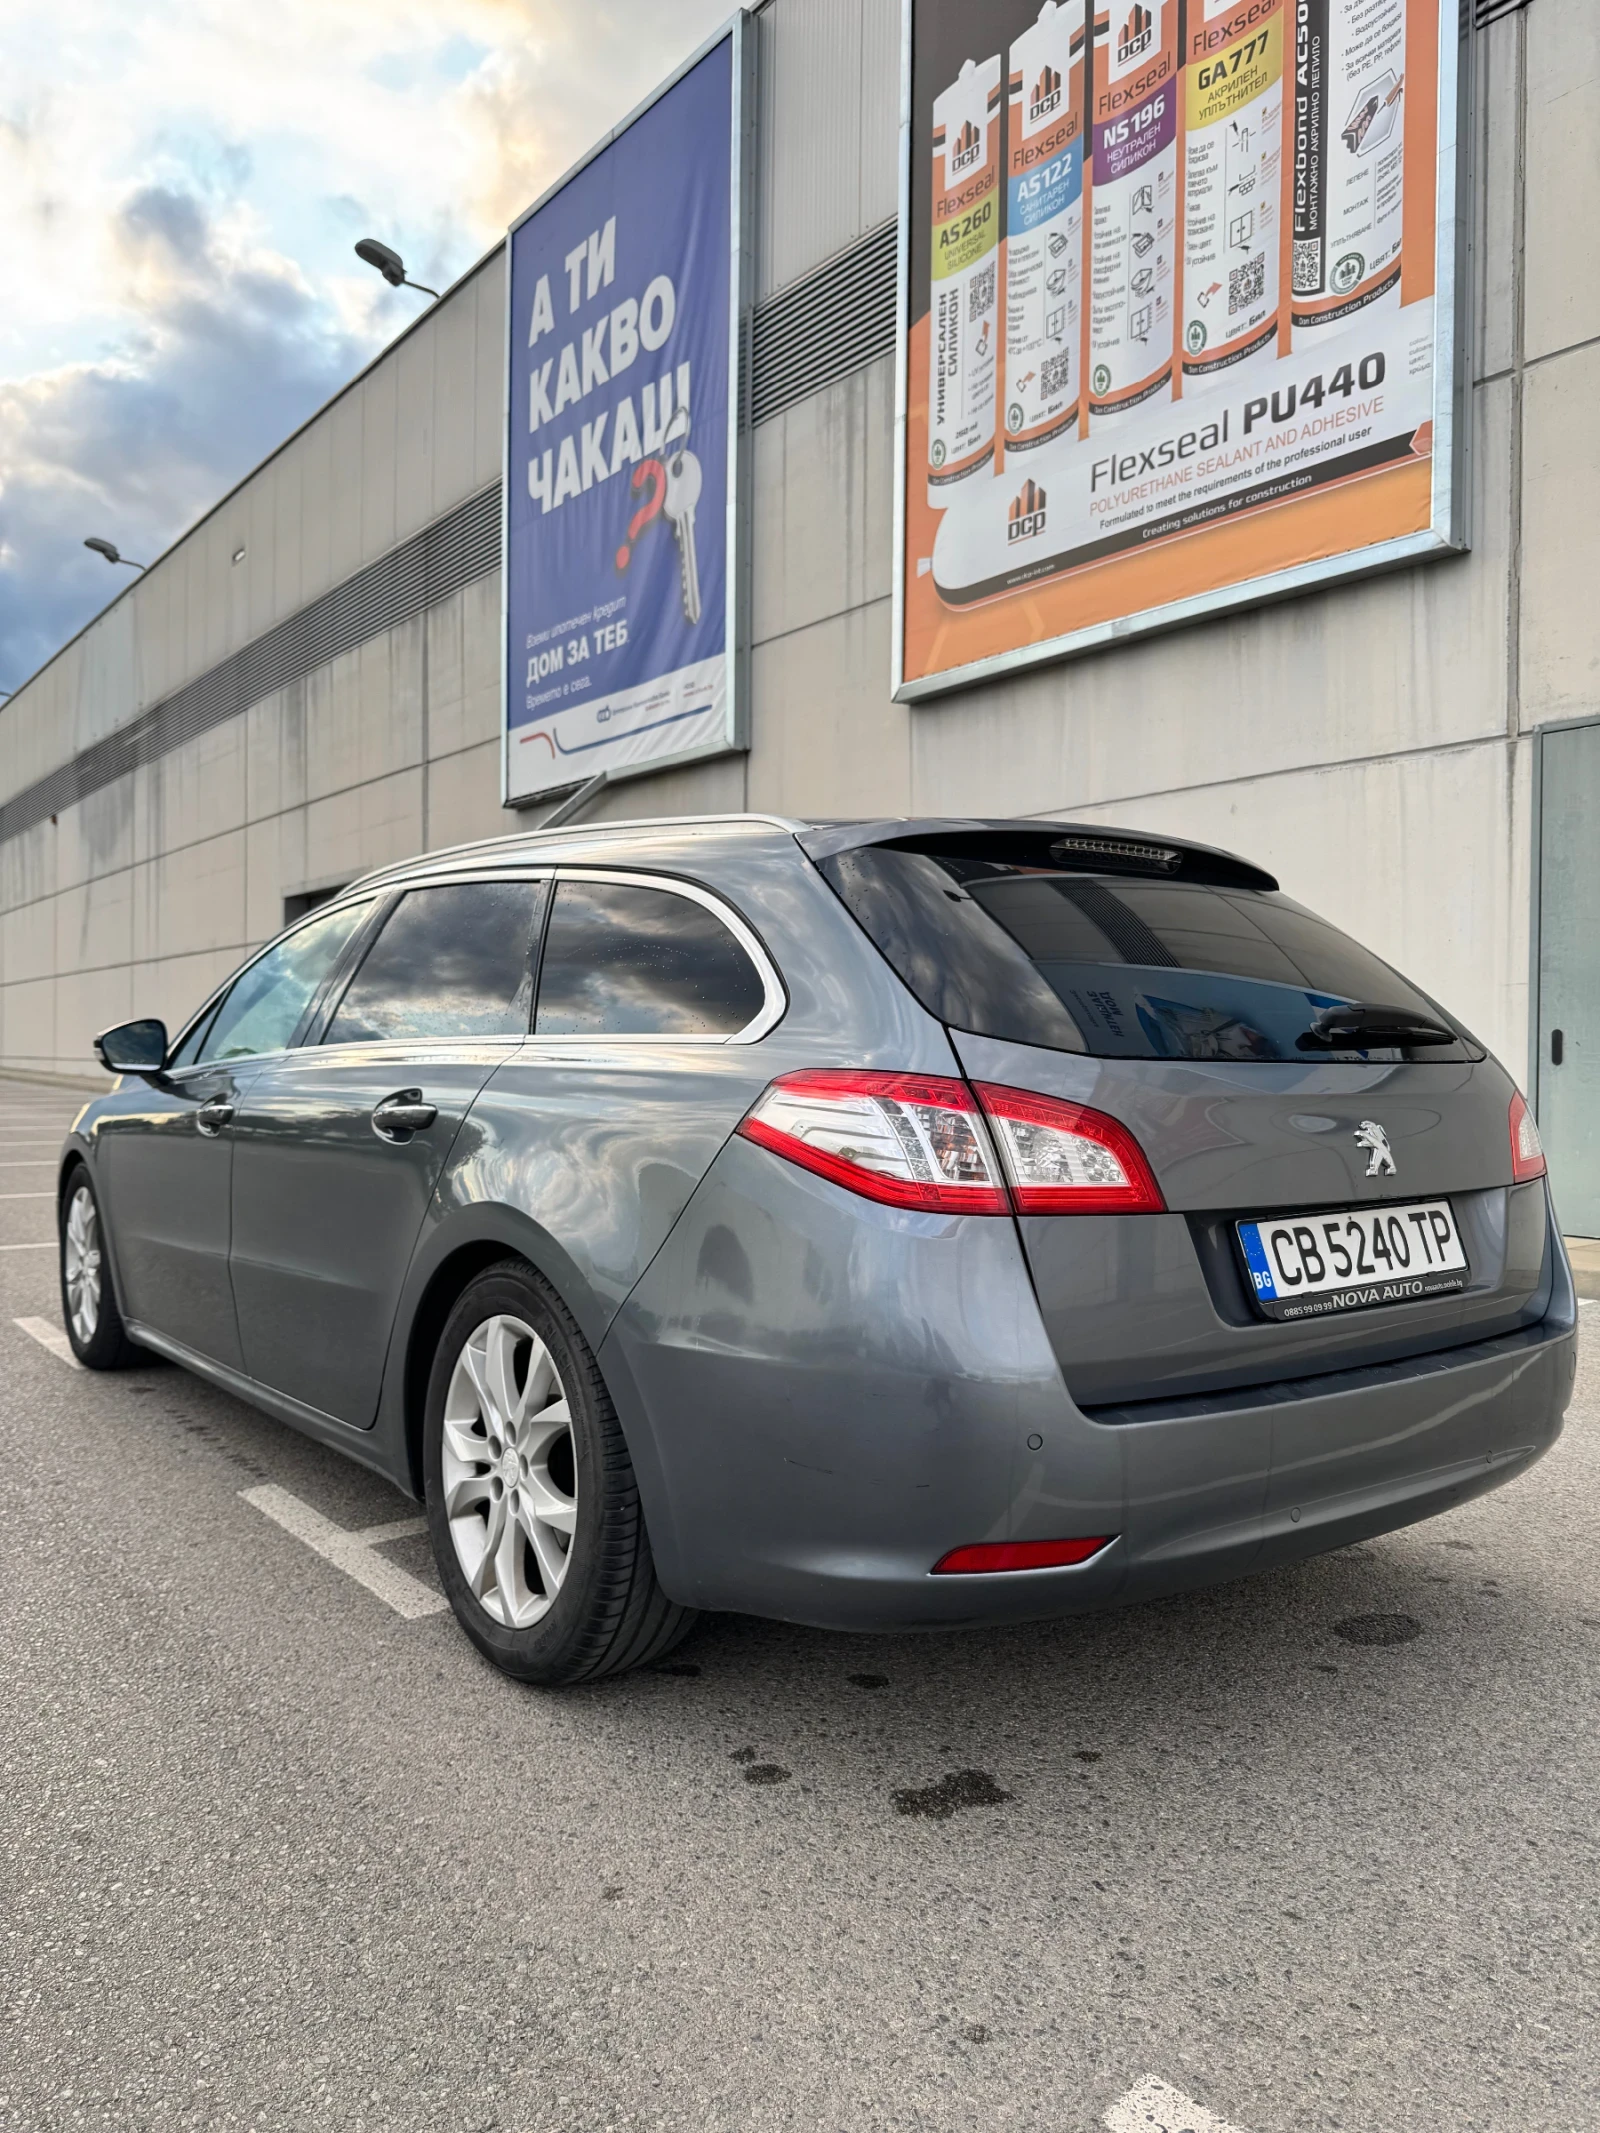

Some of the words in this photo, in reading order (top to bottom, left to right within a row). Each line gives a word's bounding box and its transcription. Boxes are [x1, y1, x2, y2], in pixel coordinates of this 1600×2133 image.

[1193, 0, 1277, 55] Flexsea
[1297, 0, 1309, 86] AC50
[1099, 51, 1171, 116] Flexseal
[1207, 64, 1258, 104] АКРИЛЕН
[1311, 36, 1321, 88] ЛЕПИЛО
[1199, 72, 1268, 121] УПЛЪТНИТЕЛ
[1310, 91, 1320, 152] АКРИЛНО
[1013, 112, 1078, 170] Flexseal
[1106, 122, 1161, 164] НЕУТРАЛЕН
[1110, 137, 1157, 175] СИЛИКОН
[1294, 97, 1308, 231] Flexbond
[936, 165, 995, 218] Flexseal
[1020, 179, 1070, 216] САНИТАРЕН
[1023, 195, 1065, 227] СИЛИКОН
[1309, 154, 1320, 231] МОНТАЖНО
[1343, 197, 1369, 216] МОНТАЖ
[528, 273, 555, 348] А
[565, 215, 616, 315] ТИ
[1311, 299, 1362, 324] Construction
[1363, 278, 1394, 303] Products
[529, 274, 676, 434] КАКВО
[937, 293, 947, 426] УНИВЕРСАЛЕН
[948, 288, 959, 377] СИЛИКОН
[1198, 350, 1243, 374] Construction
[1243, 332, 1272, 361] Products
[1091, 409, 1229, 493] Flexseal
[1243, 352, 1386, 436] PU440
[1089, 466, 1194, 517] POLYURETHANE
[1196, 441, 1263, 478] SEALANT
[1265, 427, 1298, 454] AND
[1300, 396, 1385, 441] ADHESIVE
[1100, 504, 1145, 530] Formulated
[1145, 503, 1154, 514] to
[1155, 495, 1177, 512] meet
[1178, 489, 1193, 505] the
[1193, 467, 1253, 504] requirements
[1255, 460, 1265, 476] of
[1266, 456, 1282, 472] the
[1284, 433, 1346, 469] professional
[1348, 426, 1373, 444] user
[1142, 518, 1181, 538] Creating
[1182, 502, 1226, 525] solutions
[1228, 495, 1244, 510] for
[1246, 473, 1313, 504] construction
[526, 646, 563, 688] ДОМ
[567, 635, 590, 666] ЗА
[1253, 1271, 1272, 1289] BG
[1332, 1289, 1380, 1308] NOVA
[1382, 1281, 1423, 1299] AUTO
[1284, 1306, 1304, 1318] 0885
[1303, 1304, 1313, 1314] 99
[1313, 1302, 1323, 1313] 09
[1323, 1300, 1333, 1311] 99
